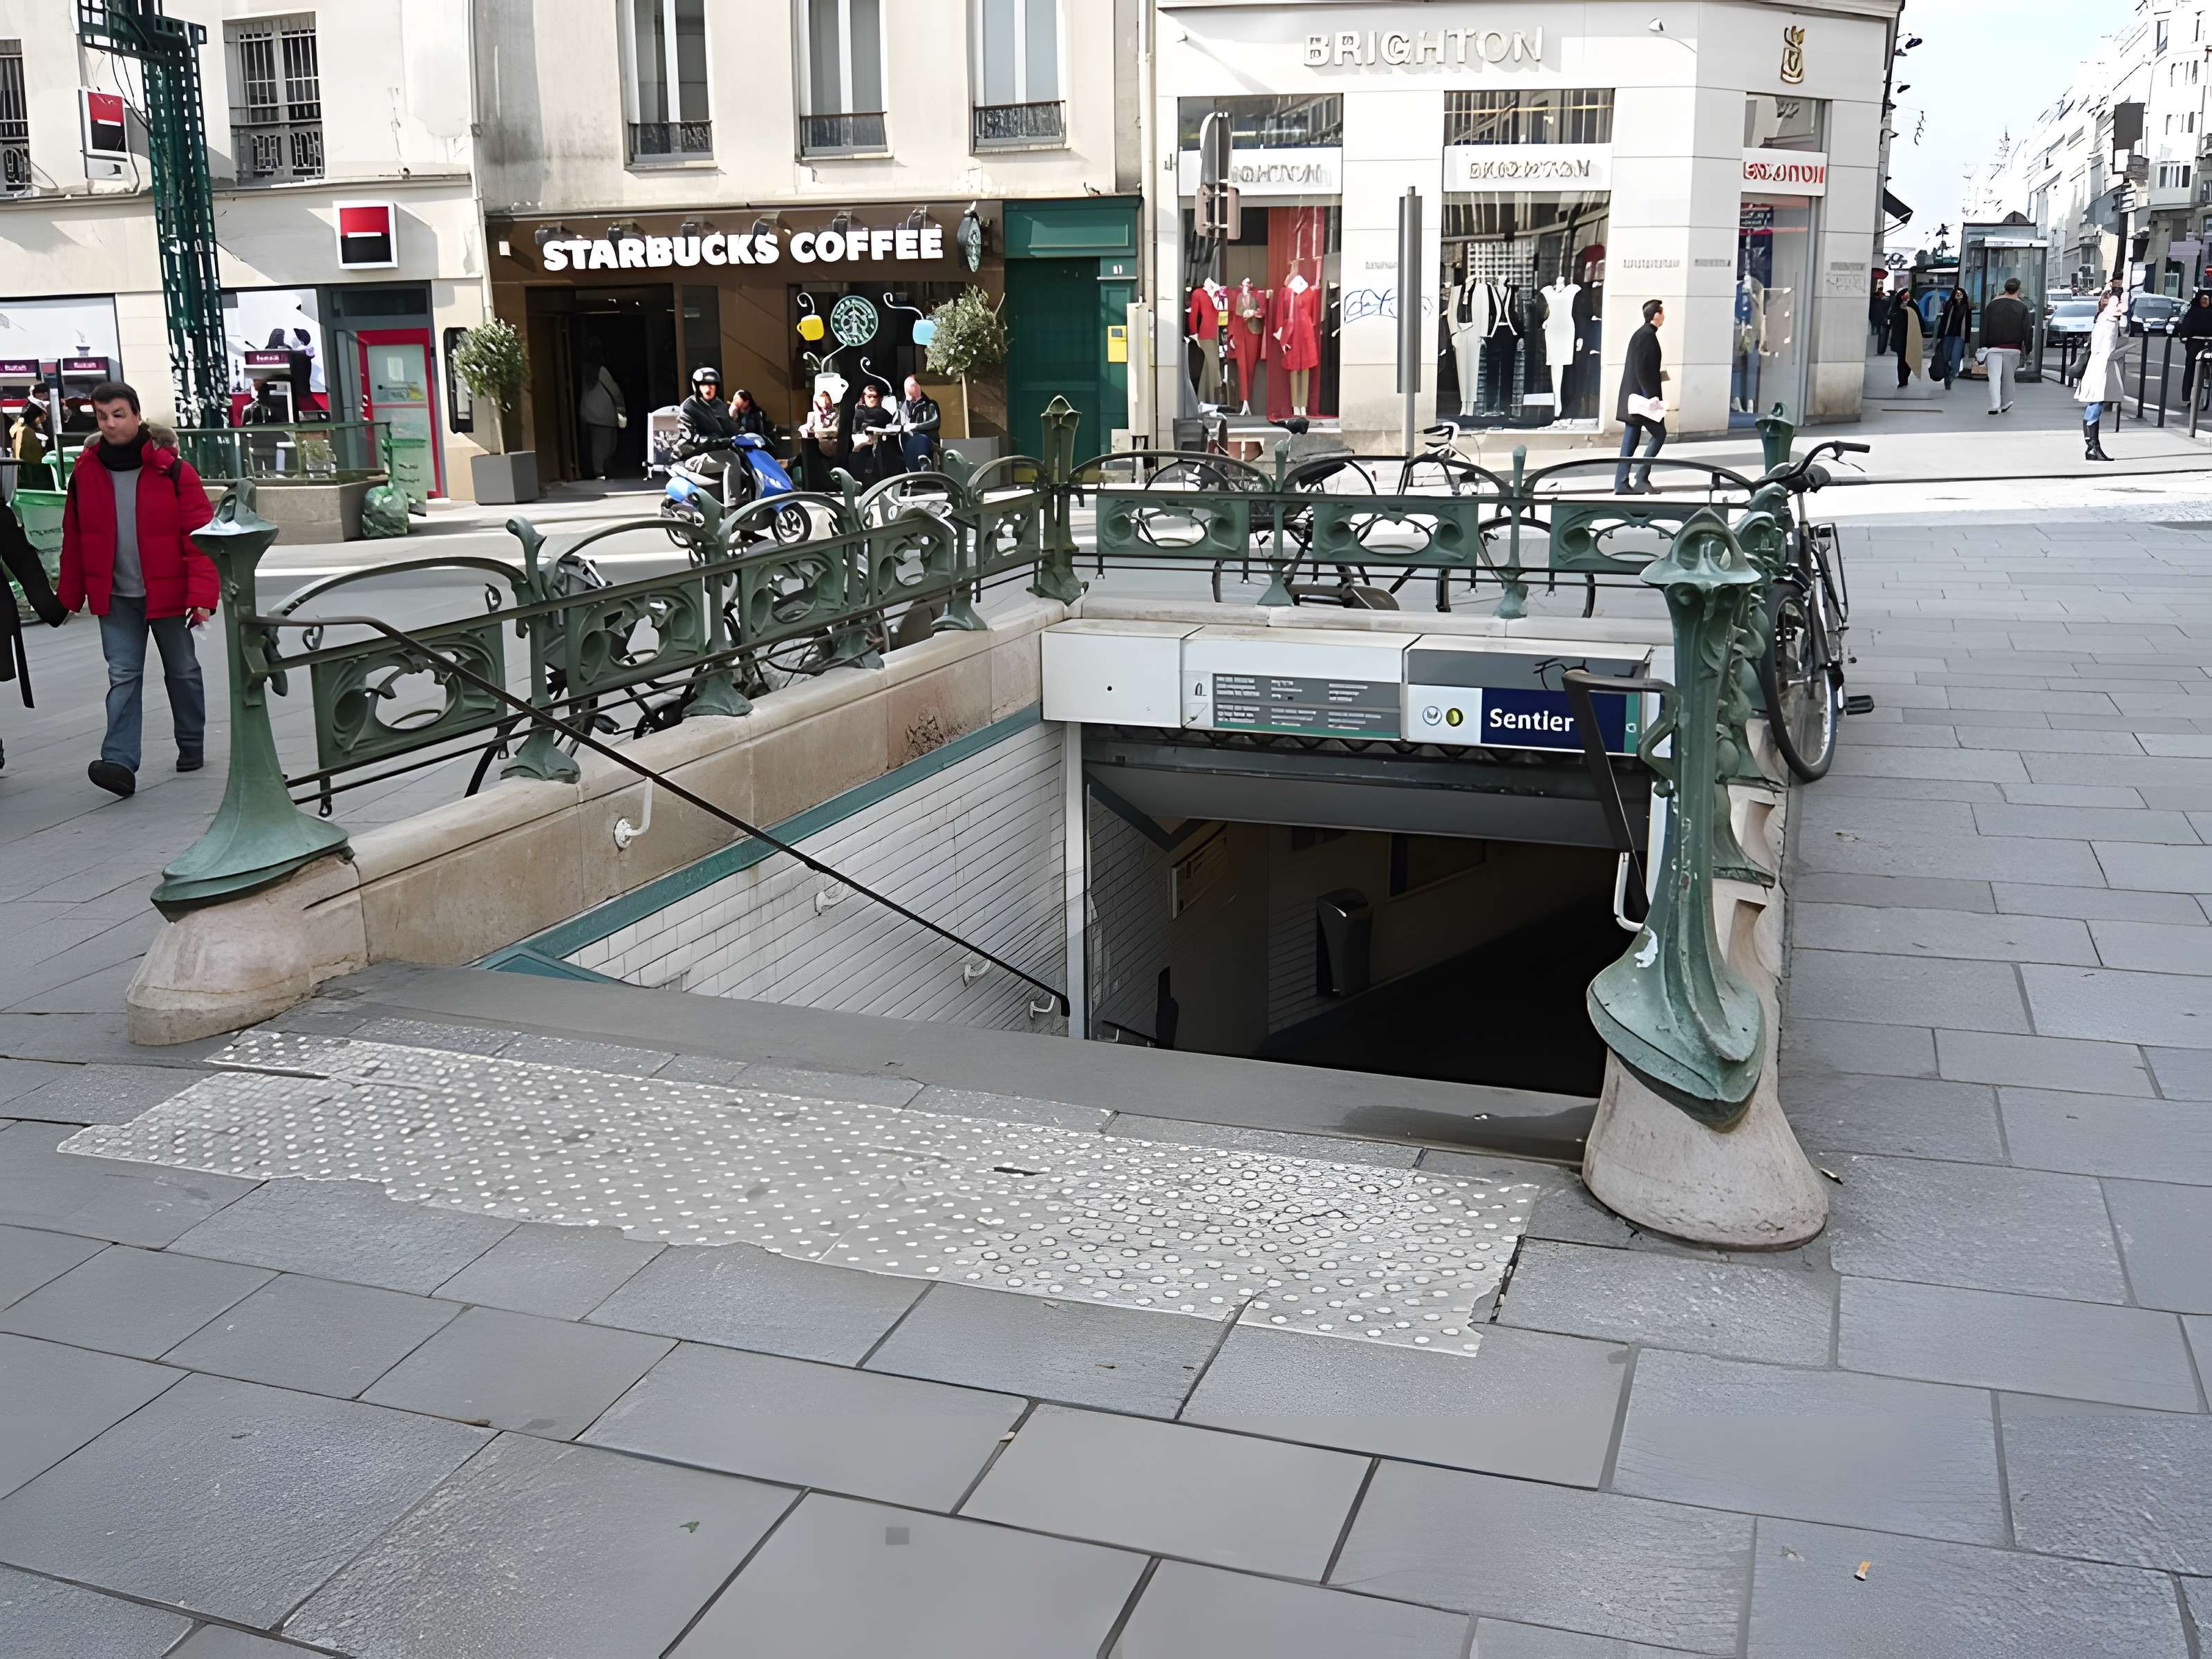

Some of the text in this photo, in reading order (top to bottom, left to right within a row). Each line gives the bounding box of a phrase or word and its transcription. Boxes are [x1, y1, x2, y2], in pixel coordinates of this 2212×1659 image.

[1304, 26, 1544, 66] BRIGHTON
[543, 234, 780, 271] STARBUCKS
[791, 229, 943, 263] COFFEE
[1490, 708, 1574, 733] Sentier
